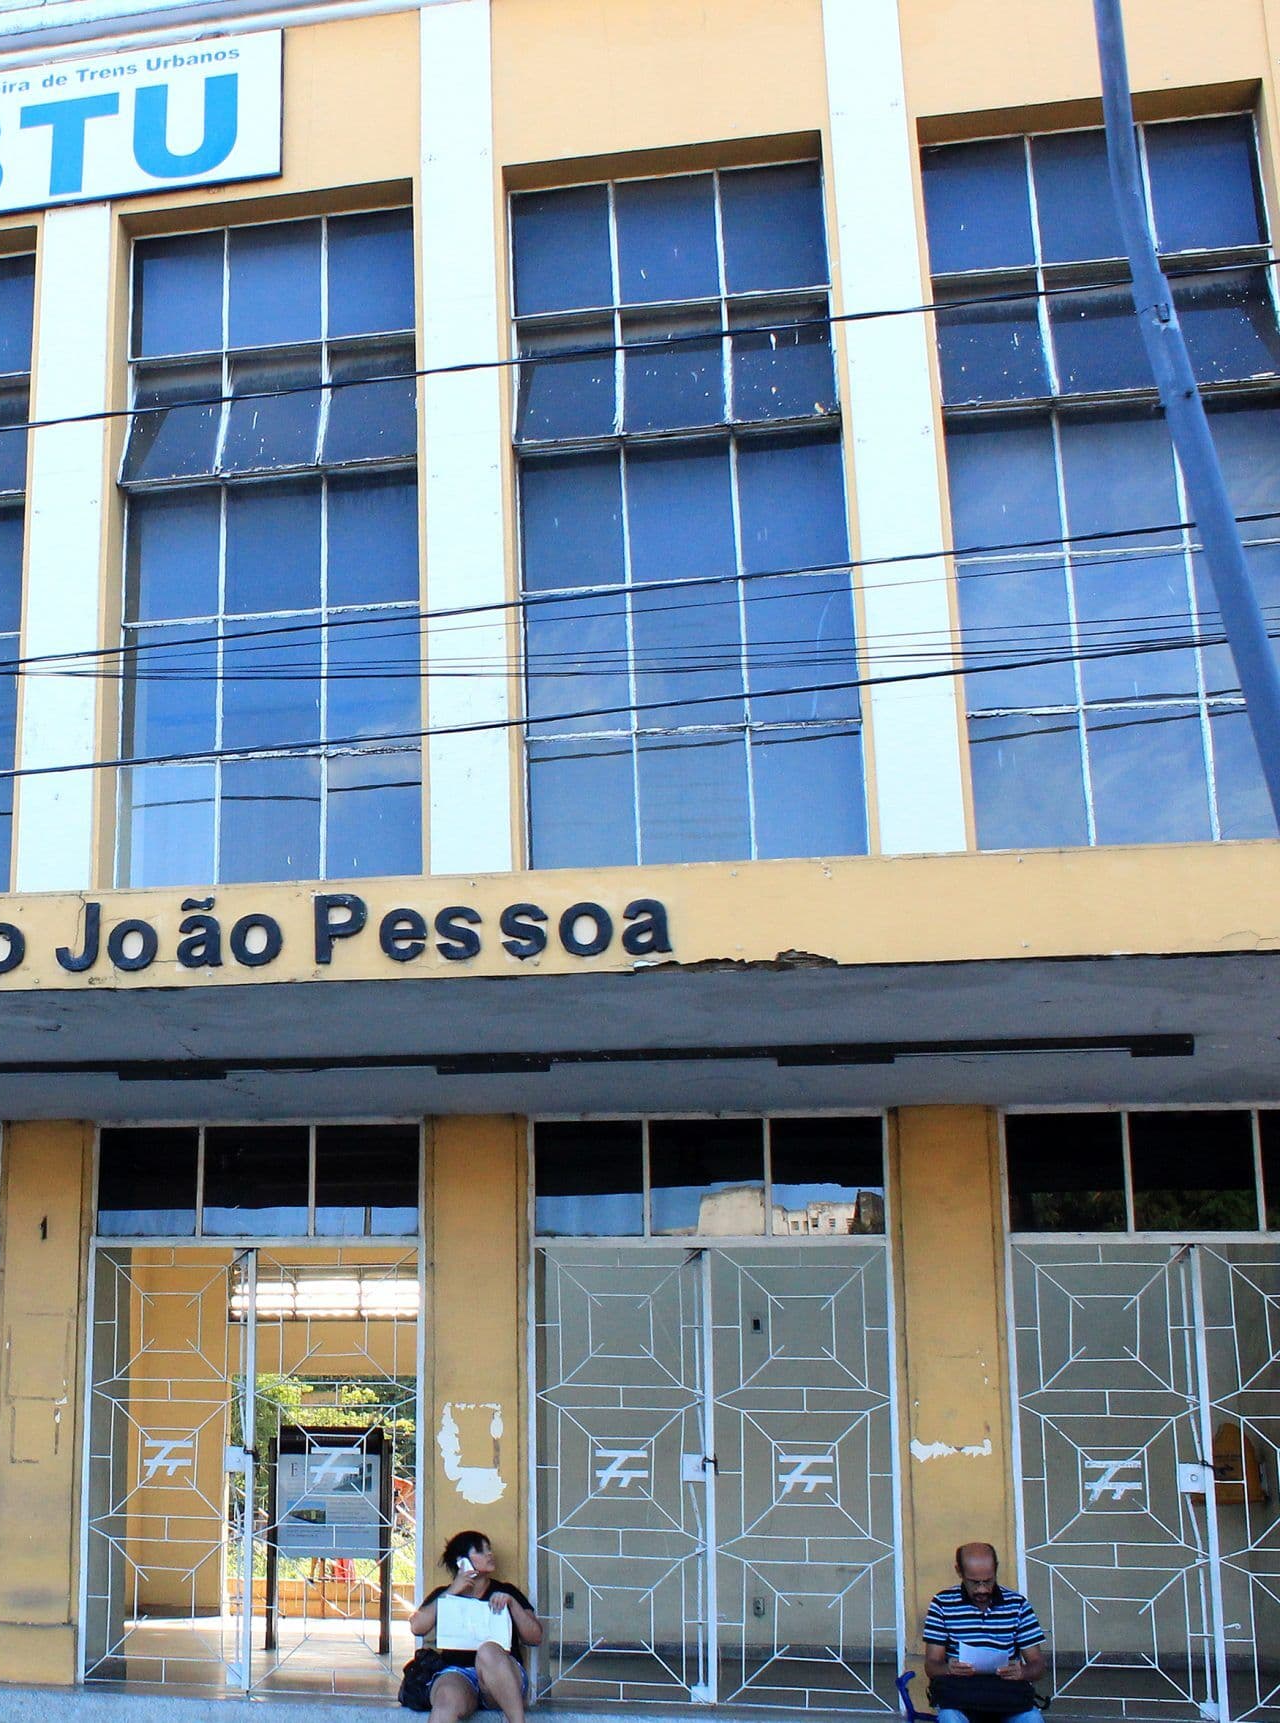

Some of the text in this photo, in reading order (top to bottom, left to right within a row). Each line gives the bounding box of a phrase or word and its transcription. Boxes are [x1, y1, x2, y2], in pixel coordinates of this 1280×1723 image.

[42, 73, 67, 89] de
[76, 63, 138, 83] Trens
[146, 48, 240, 72] Urbanos
[55, 897, 283, 972] João
[314, 893, 672, 964] Pessoa
